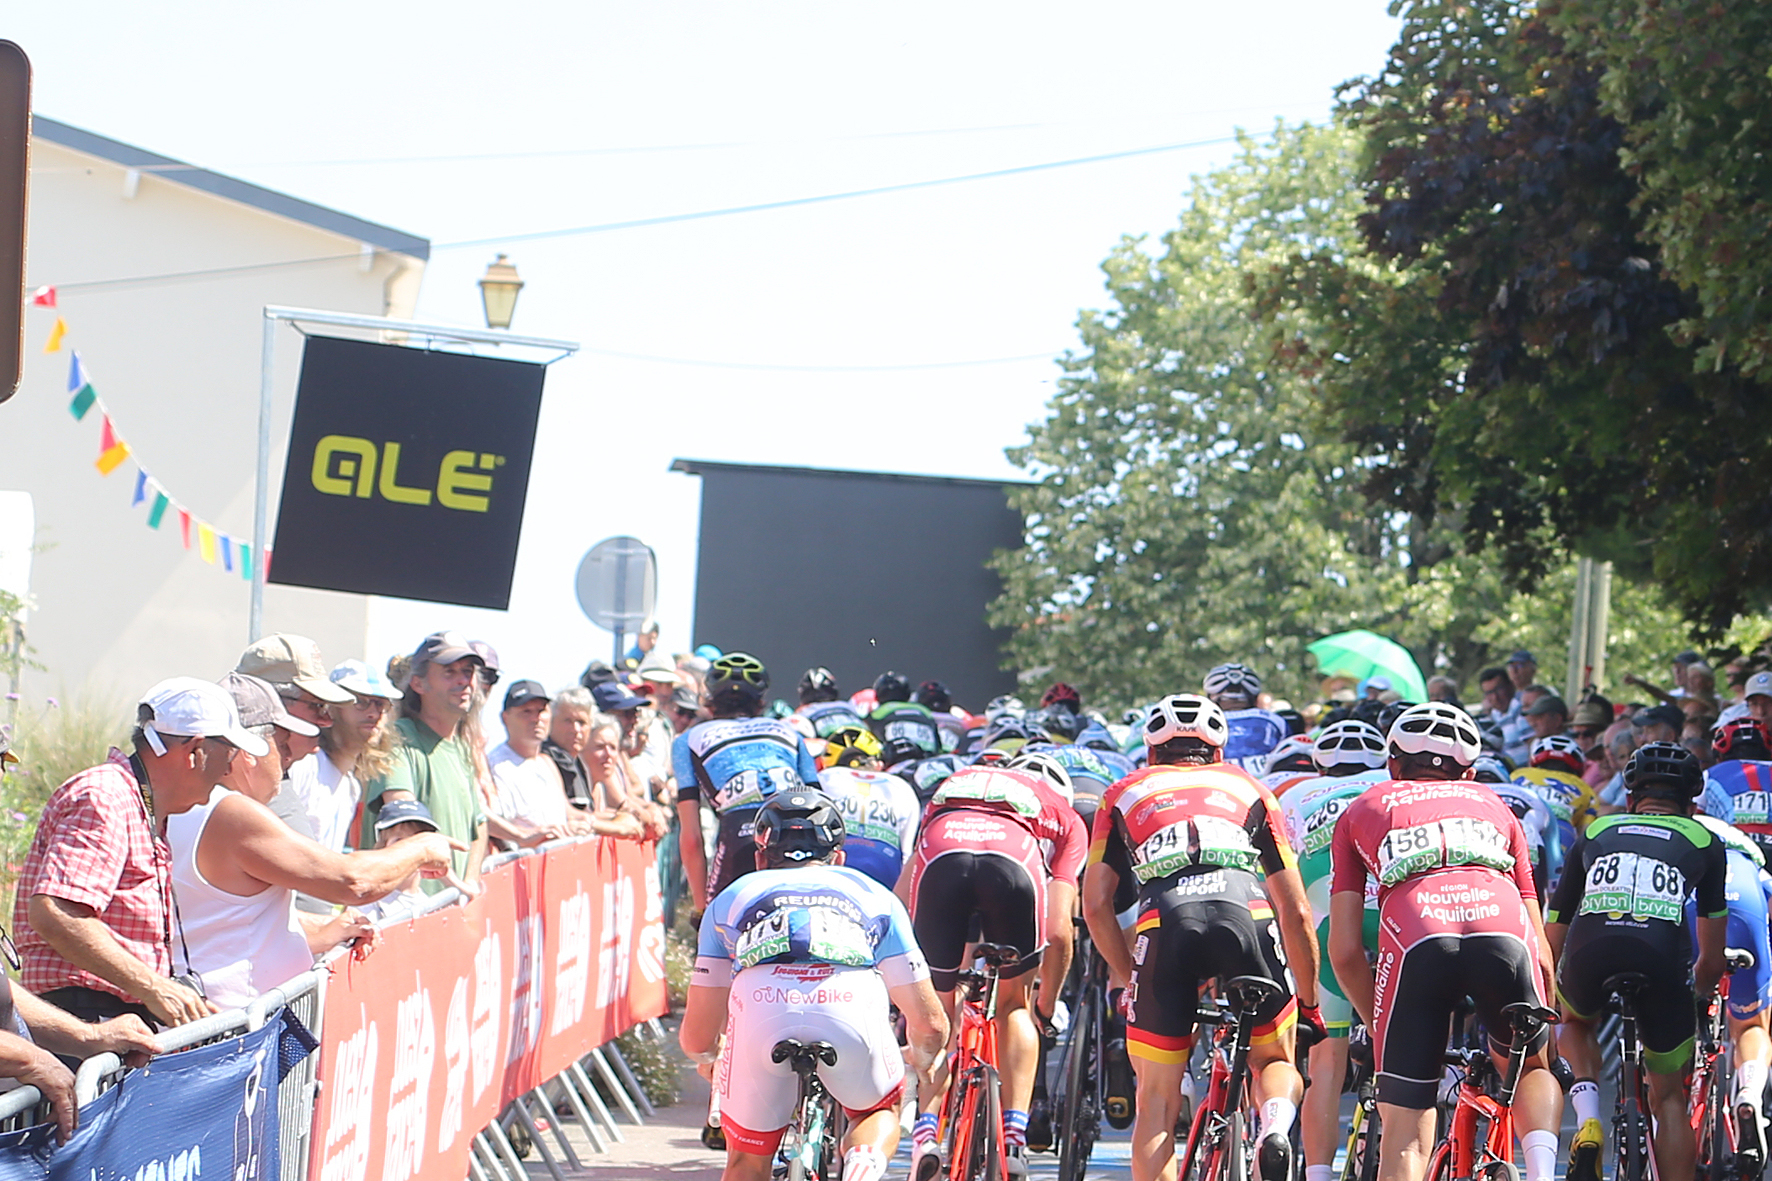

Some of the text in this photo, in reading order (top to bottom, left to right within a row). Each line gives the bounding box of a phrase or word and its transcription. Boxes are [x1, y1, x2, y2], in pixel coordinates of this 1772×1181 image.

[1383, 827, 1430, 860] 158
[1178, 870, 1224, 886] DIFFU
[1593, 856, 1679, 896] 68 68
[1176, 881, 1227, 896] SPORT
[1417, 887, 1496, 905] Nouvelle-
[1440, 883, 1468, 891] RÉGION
[1420, 902, 1500, 924] Aquitaine
